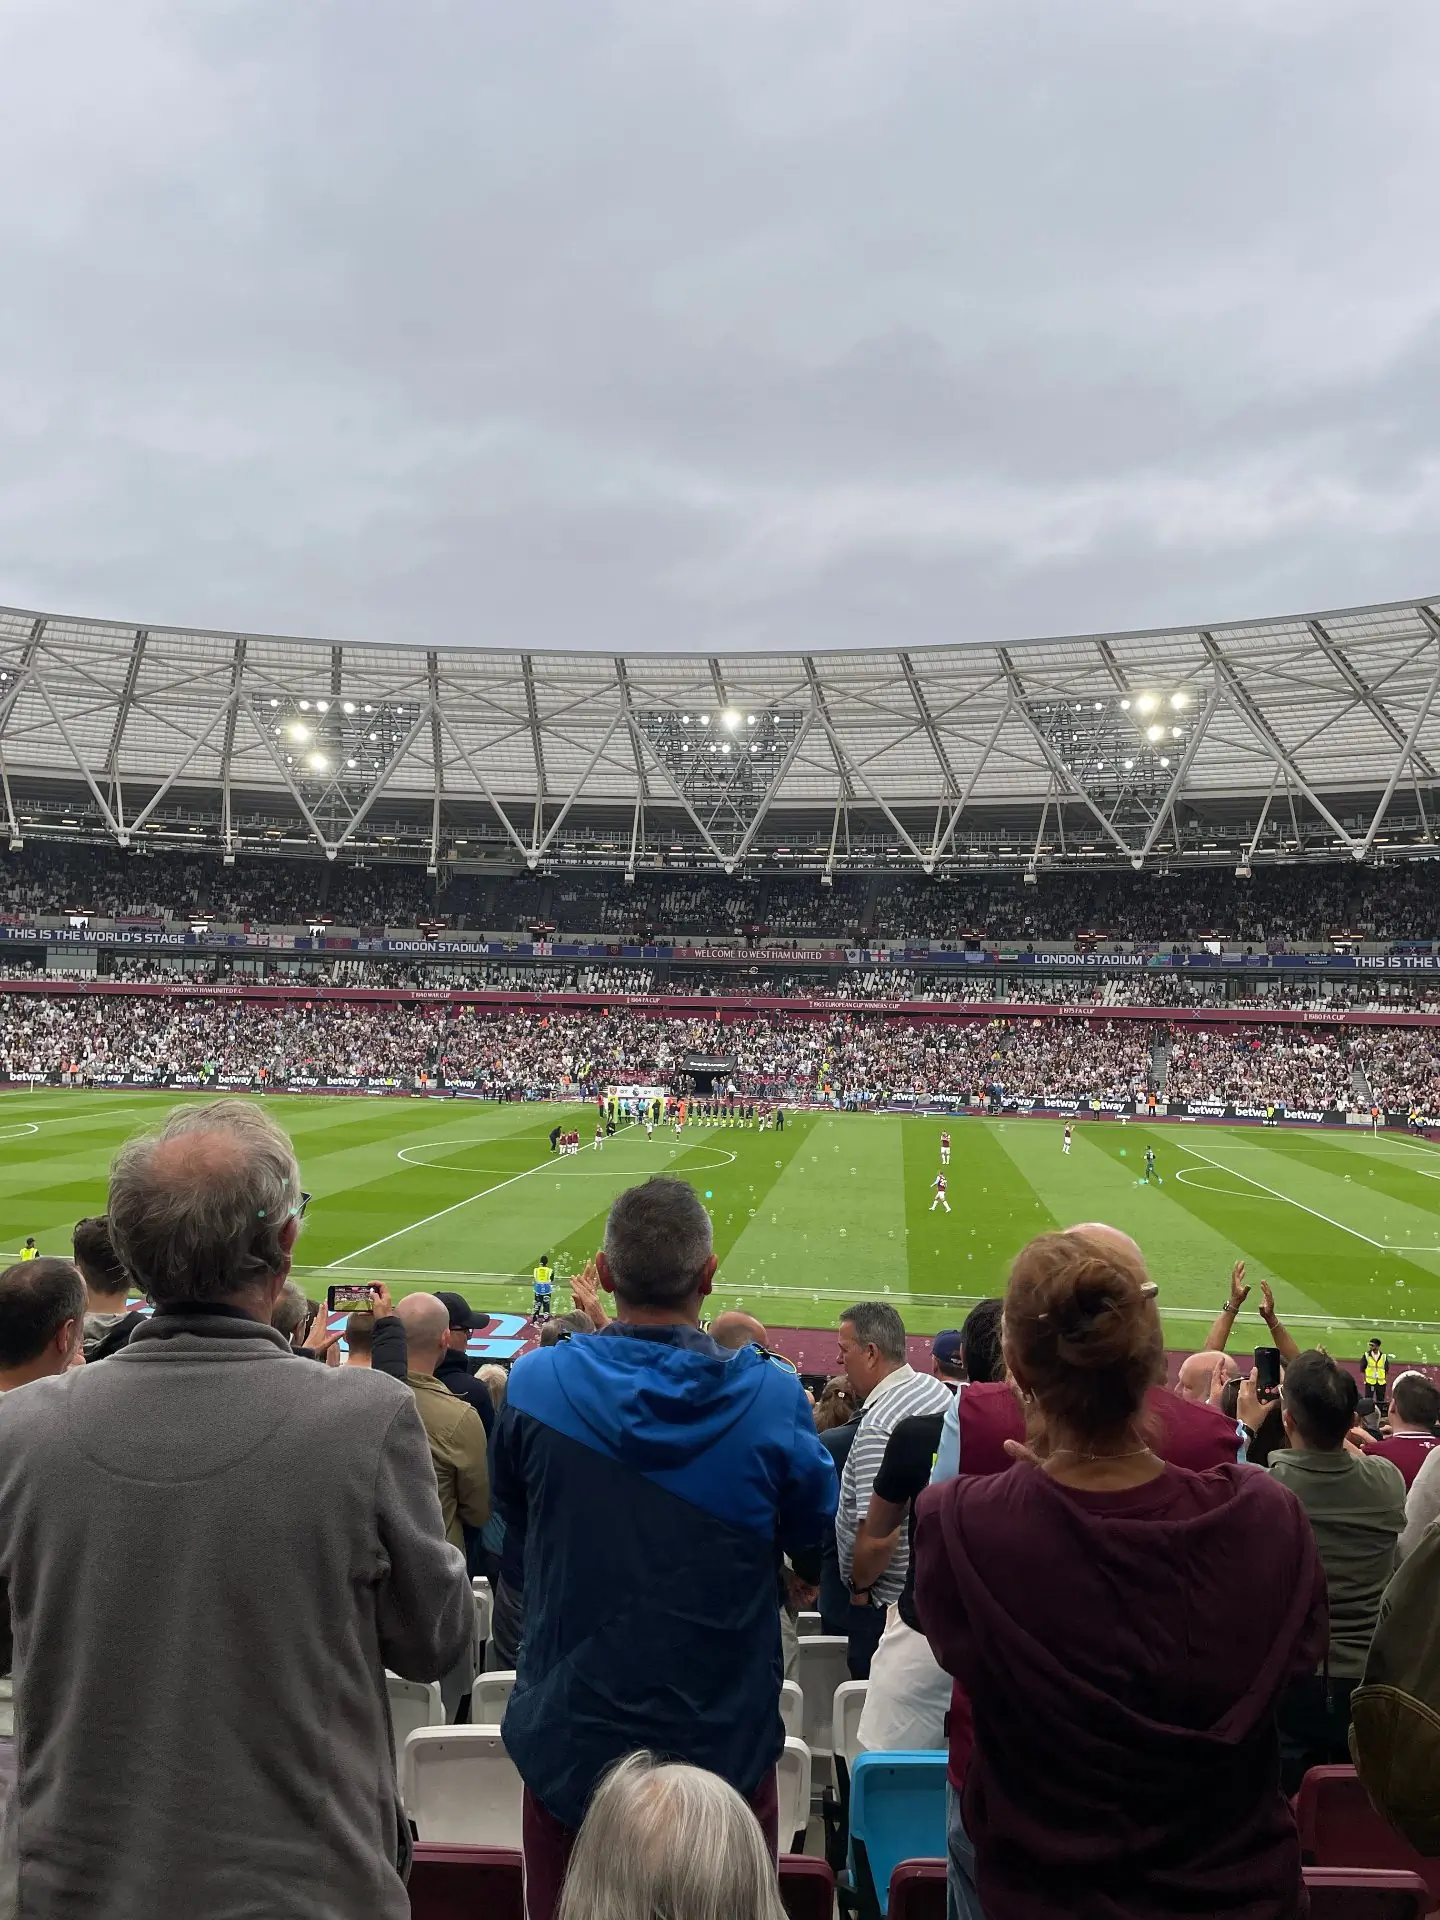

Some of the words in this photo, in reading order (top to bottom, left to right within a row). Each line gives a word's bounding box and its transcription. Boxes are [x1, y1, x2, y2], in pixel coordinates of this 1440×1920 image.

[6, 929, 36, 939] THIS
[40, 930, 51, 940] IS
[55, 930, 81, 941] THE
[84, 931, 142, 943] WORLD'S
[145, 934, 185, 944] STAGE
[389, 942, 436, 952] LONDON
[438, 943, 489, 953] STADIUM
[694, 949, 736, 959] WELCOME
[738, 950, 748, 959] TO
[749, 950, 771, 960] WEST
[772, 951, 791, 960] HAM
[791, 951, 822, 960] UNITED
[1034, 954, 1085, 964] LONDON
[1087, 955, 1143, 965] STADIUM
[1352, 956, 1385, 968] THIS
[1388, 956, 1401, 968] IS
[1404, 956, 1433, 968] THE
[9, 1072, 47, 1082] betway
[93, 1074, 125, 1083] etway
[175, 1074, 210, 1085] betwy
[218, 1075, 252, 1086] betway
[289, 1076, 319, 1087] etway
[327, 1077, 361, 1087] betway
[1044, 1098, 1080, 1110] betway
[1088, 1100, 1126, 1113] btway
[1187, 1105, 1226, 1117] betway
[1235, 1107, 1268, 1117] betwa
[1284, 1110, 1324, 1122] betway
